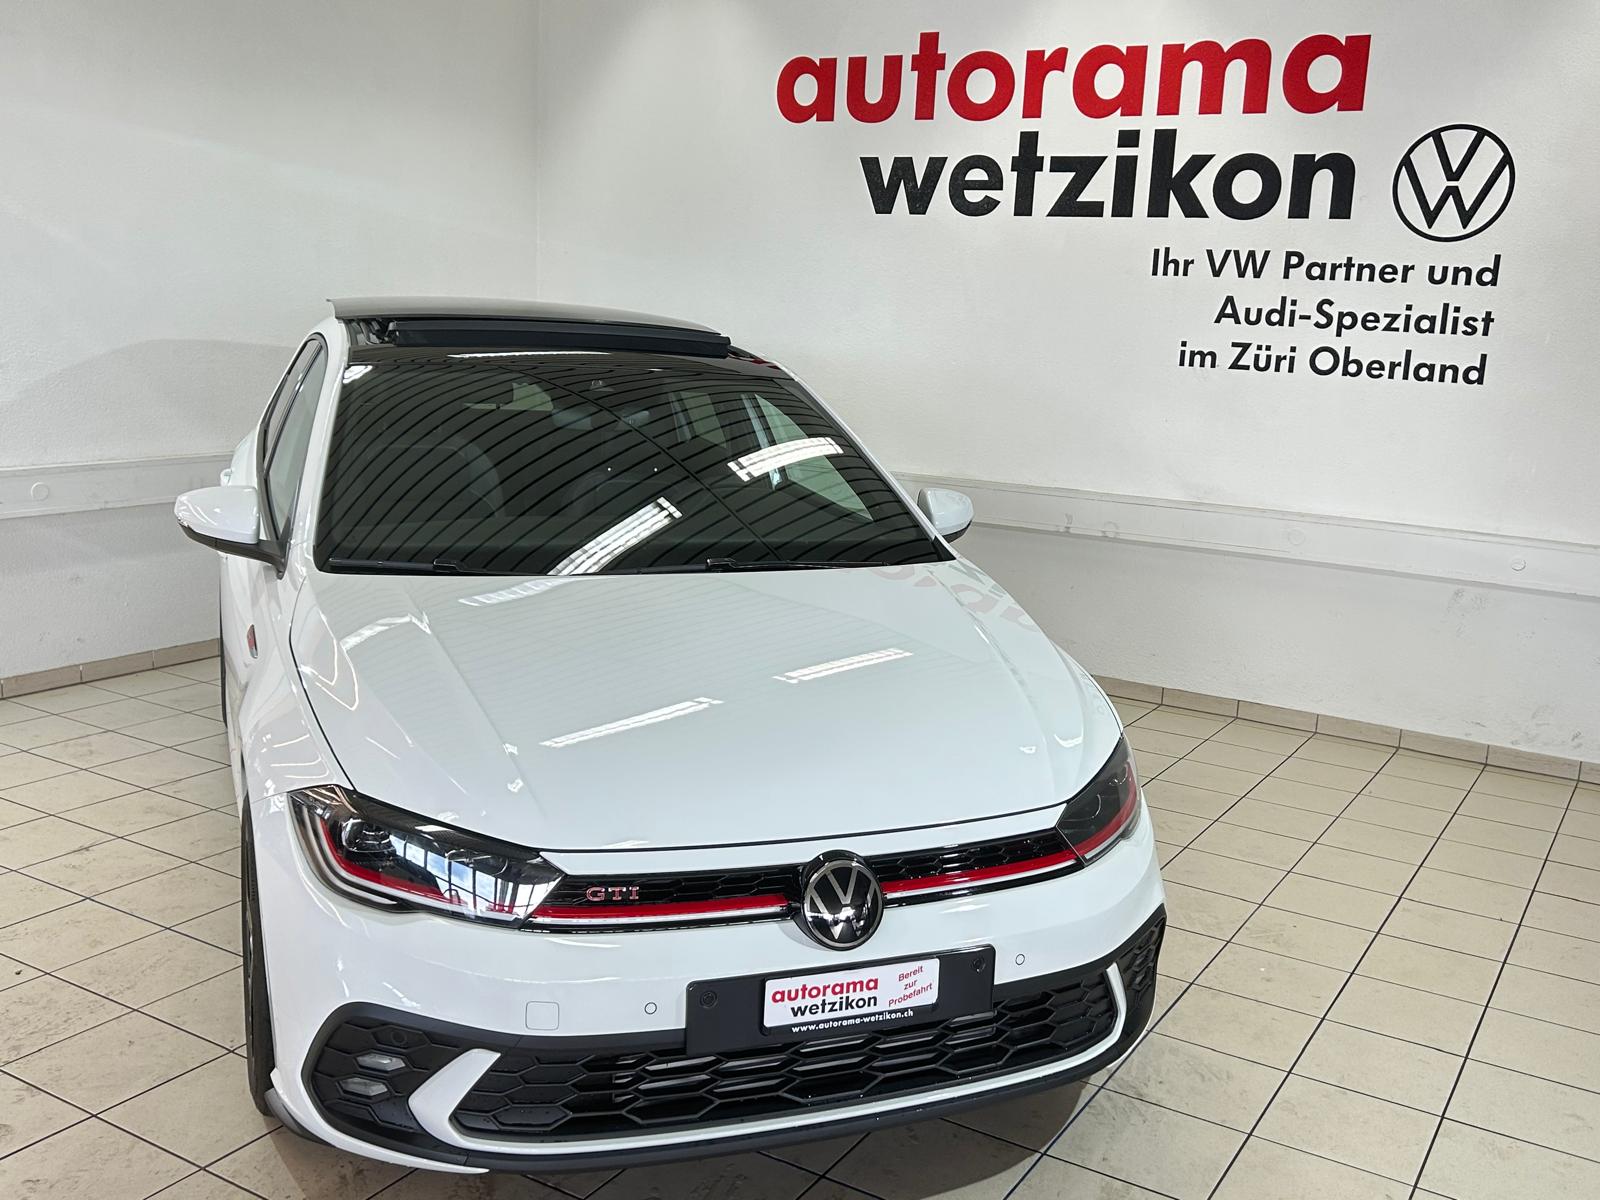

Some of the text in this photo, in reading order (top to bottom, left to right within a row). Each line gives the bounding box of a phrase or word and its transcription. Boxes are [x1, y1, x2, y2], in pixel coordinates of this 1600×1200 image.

[777, 32, 1371, 124] autorama
[860, 128, 1356, 220] wetzikon
[1393, 124, 1515, 242] VW
[1151, 247, 1502, 287] Ihr VW Partner und
[1213, 295, 1495, 338] Audi-Spezialist
[1178, 341, 1488, 386] im Züri Oberland
[586, 886, 640, 902] GTI
[803, 859, 883, 948] VW
[898, 965, 923, 982] Bereit
[903, 979, 918, 991] zur
[771, 977, 879, 1004] autorama
[790, 995, 878, 1018] wetzikon
[888, 982, 933, 1008] Probefahrt
[791, 1008, 914, 1033] www.autorama-wetzikon.ch
